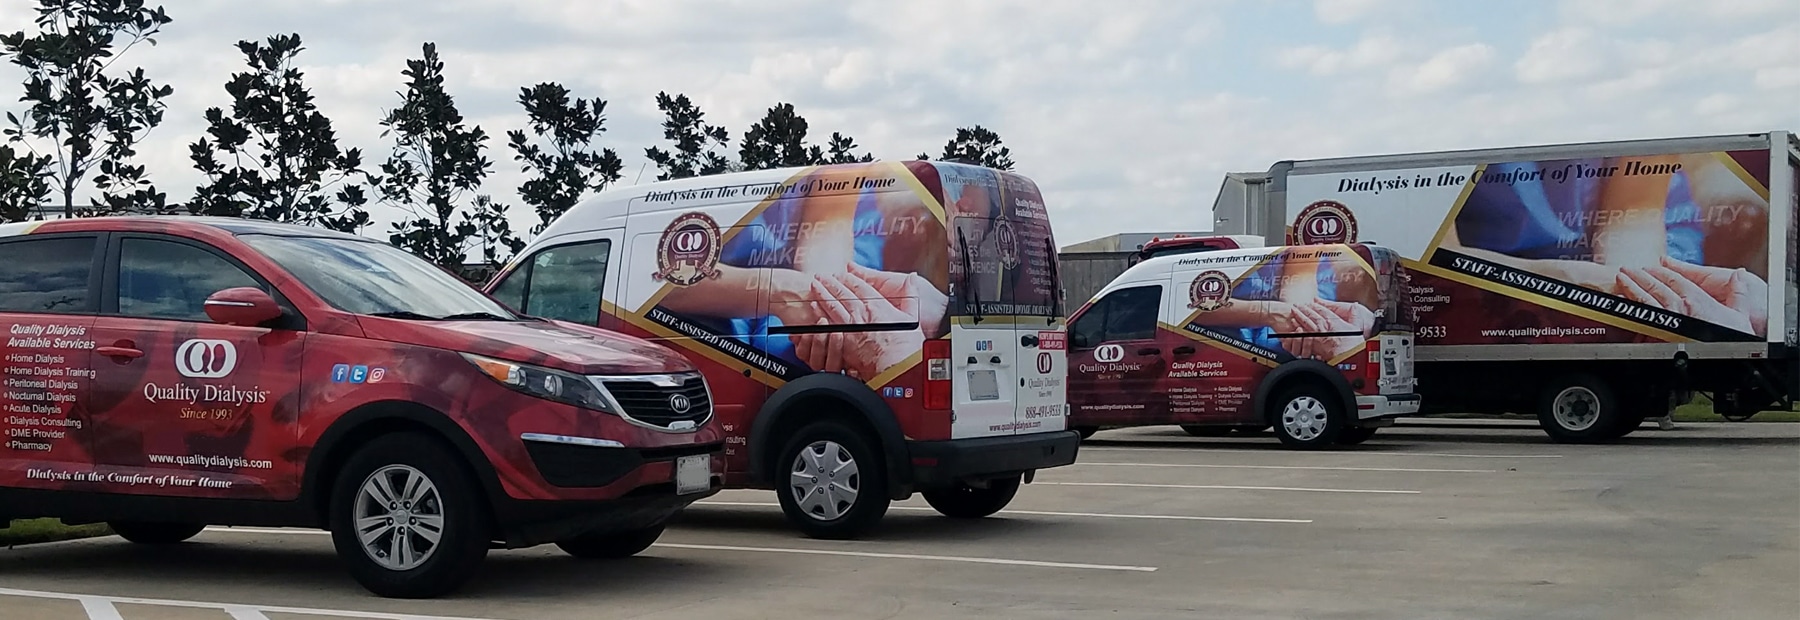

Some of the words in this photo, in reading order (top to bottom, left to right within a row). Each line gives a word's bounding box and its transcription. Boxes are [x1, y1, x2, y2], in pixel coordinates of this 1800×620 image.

[1337, 175, 1409, 195] Dialysis
[1414, 174, 1431, 188] in
[1437, 172, 1465, 187] the
[1471, 167, 1546, 187] Comfort
[1551, 164, 1573, 184] of
[1576, 163, 1618, 179] Your
[1624, 161, 1682, 176] Home
[645, 189, 698, 205] Dialysis
[700, 188, 713, 199] in
[717, 186, 738, 198] the
[742, 182, 797, 199] Comfort
[800, 179, 815, 197] of
[818, 178, 849, 192] Your
[853, 176, 895, 189] Home
[1558, 208, 1640, 228] WHERE
[751, 221, 827, 242] WHERE
[1178, 257, 1213, 266] Dialysis
[1280, 253, 1291, 261] of
[1292, 251, 1312, 259] Your
[1315, 250, 1342, 258] Home
[1452, 257, 1567, 297] STAFF-ASSISTED
[1567, 289, 1614, 310] HOME
[1614, 300, 1682, 329] DIALYSIS
[10, 323, 45, 336] Quality
[46, 324, 86, 337] Dialysis
[1481, 326, 1606, 338] www.qualitydialysis.com
[7, 337, 51, 348] Available
[53, 338, 96, 349] Services
[650, 308, 719, 345] STAFF-ASSISTED
[718, 339, 748, 358] HOME
[746, 351, 788, 376] DIALYSIS
[11, 353, 33, 363] Home
[35, 354, 65, 365] Dialysis
[1172, 362, 1195, 370] Quality
[1196, 361, 1223, 369] Dialysis
[10, 366, 32, 375] Home
[34, 366, 63, 377] Dialysis
[65, 367, 96, 379] Training
[1079, 363, 1107, 373] Quality
[1109, 362, 1141, 373] Dialysis
[1168, 370, 1197, 378] Available
[9, 378, 47, 388] Peritoneal
[48, 379, 78, 391] Dialysis
[9, 391, 45, 400] Nocturnal
[46, 392, 76, 403] Dialysis
[144, 382, 200, 406] Quality
[204, 384, 267, 407] Dialysis
[9, 403, 31, 413] Acute
[32, 404, 62, 416] Dialysis
[673, 398, 688, 409] KIA
[180, 407, 207, 419] Since
[210, 408, 233, 420] 1993
[10, 415, 40, 427] Dialysis
[41, 416, 82, 429] Consulting
[11, 428, 31, 437] DME
[33, 429, 65, 438] Provider
[12, 440, 52, 452] Pharmacy
[149, 453, 272, 470] www.qualitydialysis.com
[27, 468, 71, 483] Dialysis
[74, 470, 86, 482] in
[88, 471, 105, 482] the
[107, 472, 152, 486] Comfort
[155, 474, 168, 487] of
[169, 475, 196, 487] Your
[198, 476, 233, 489] Home
